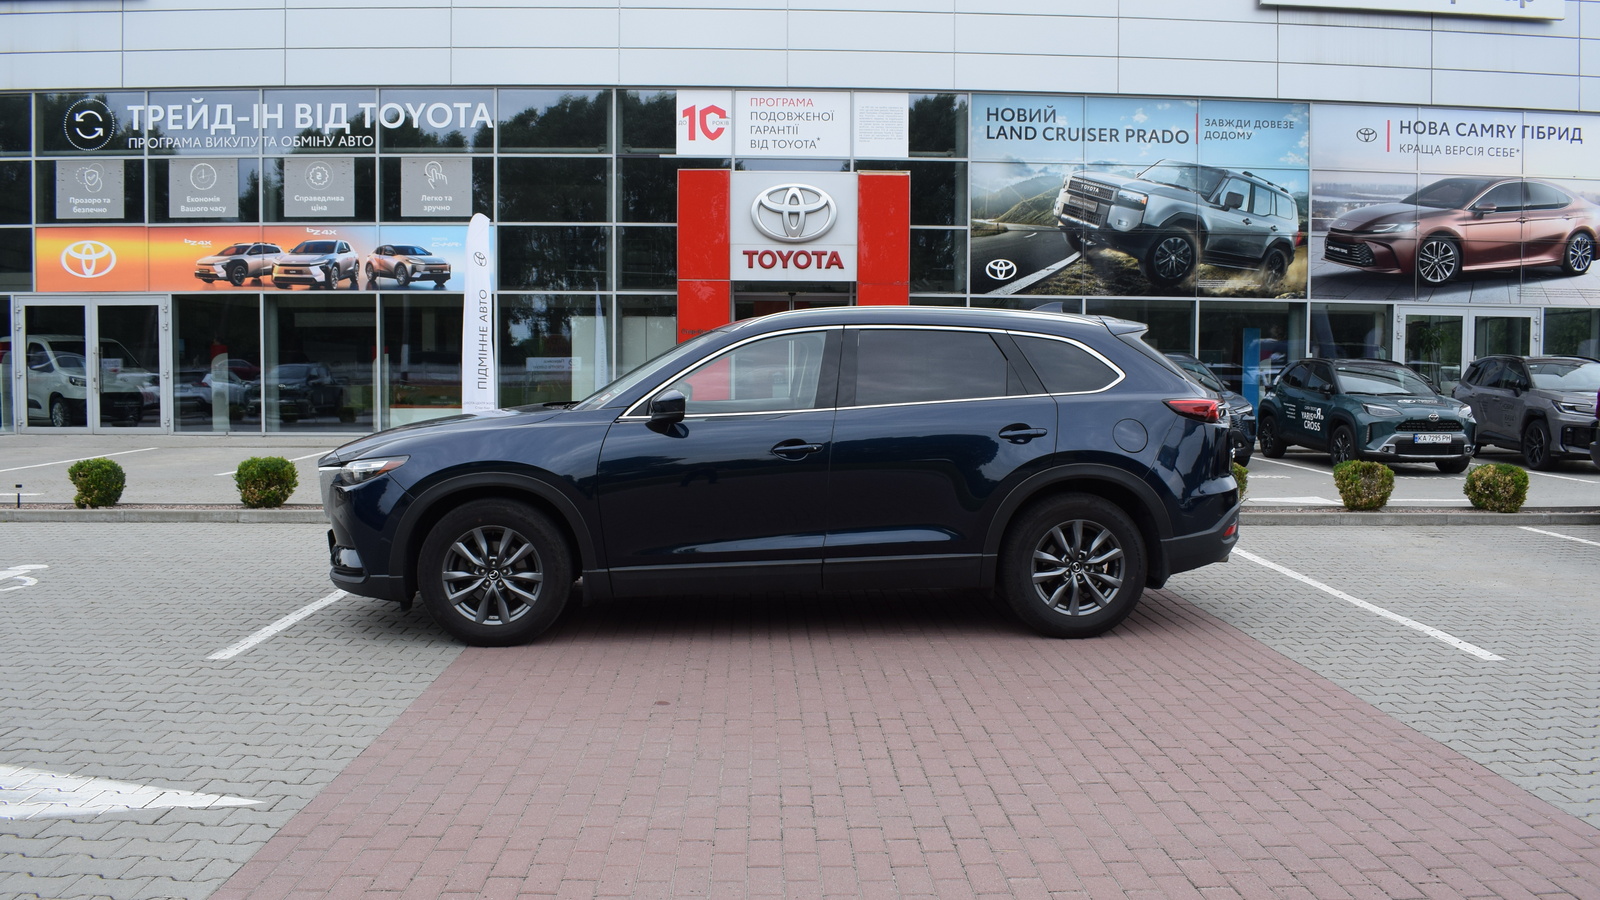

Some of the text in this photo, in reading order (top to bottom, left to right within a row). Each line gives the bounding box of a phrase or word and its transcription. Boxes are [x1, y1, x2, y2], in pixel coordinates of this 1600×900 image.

[749, 97, 814, 107] ПРОГРАМА
[127, 97, 494, 136] ТРЕЙД-ІН ВІД TOYOTA
[750, 110, 835, 122] ПОДОВЖЕНОЇ
[986, 105, 1057, 123] НОВИЙ
[750, 123, 800, 135] ГАРАНТІЇ
[1204, 118, 1295, 130] ЗАВЖДИ ДОВЕЗЕ
[986, 125, 1190, 145] LAND CRUISER PRADO
[1203, 130, 1253, 140] ДОДОМУ
[1400, 120, 1583, 145] НОВА CAMRY ГІБРИД
[128, 135, 374, 149] ПРОГРАМА ВИКУПУ ТА ОБМІНУ АВТО
[750, 139, 769, 150] ВІД
[1399, 143, 1442, 156] КРАЩА
[1445, 145, 1485, 157] ВЕРСІЯ
[69, 196, 102, 205] Прозоро
[186, 195, 221, 203] Економія
[294, 194, 345, 203] Справедлива
[421, 194, 443, 203] Легко
[72, 206, 108, 214] безпечно
[180, 205, 227, 213] Вашого часу
[310, 204, 328, 212] ціна
[422, 205, 451, 213] зручно
[743, 250, 845, 270] TOYOTA
[477, 289, 489, 390] ПІДМІННЕ АВТО
[1303, 420, 1321, 432] CROSS
